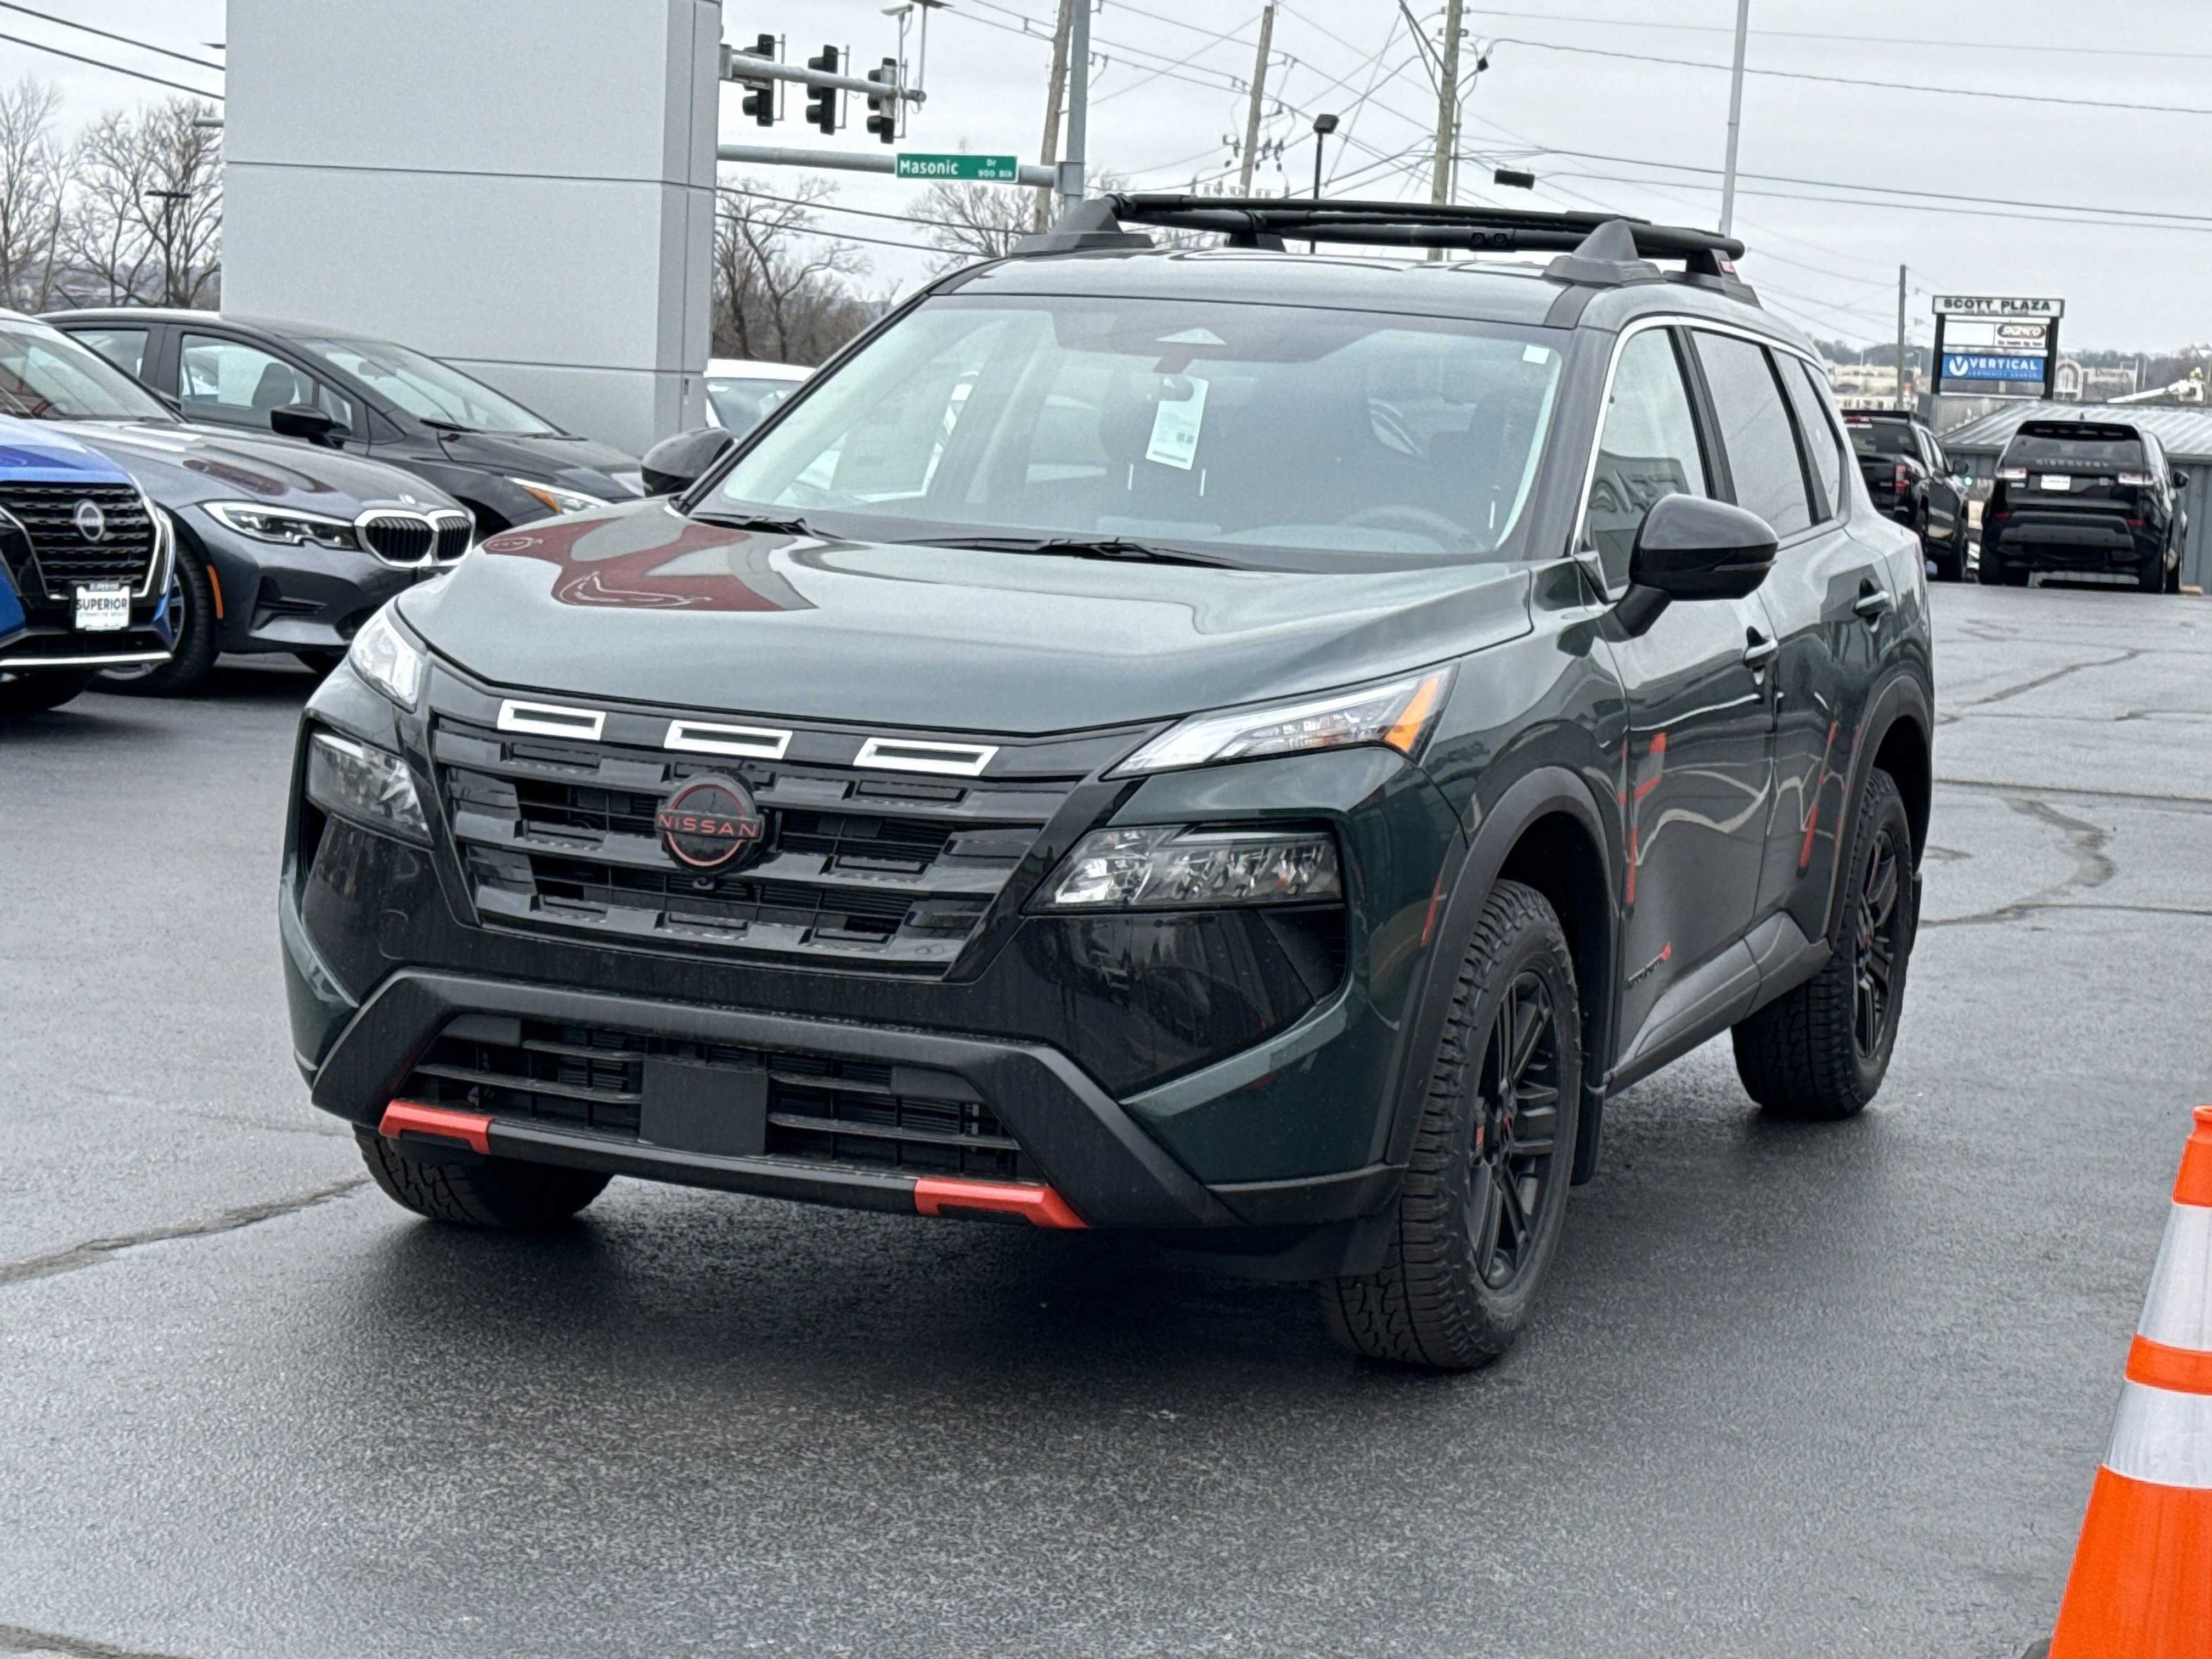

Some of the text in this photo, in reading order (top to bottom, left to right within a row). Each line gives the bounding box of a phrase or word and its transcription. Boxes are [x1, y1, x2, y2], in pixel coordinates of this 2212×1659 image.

[900, 159, 959, 175] Masonic
[1944, 298, 2051, 311] SCOTT PLAZA
[1969, 357, 2038, 370] VERTICAL
[76, 597, 127, 611] SUPERIOR
[658, 814, 759, 838] NISSAN
